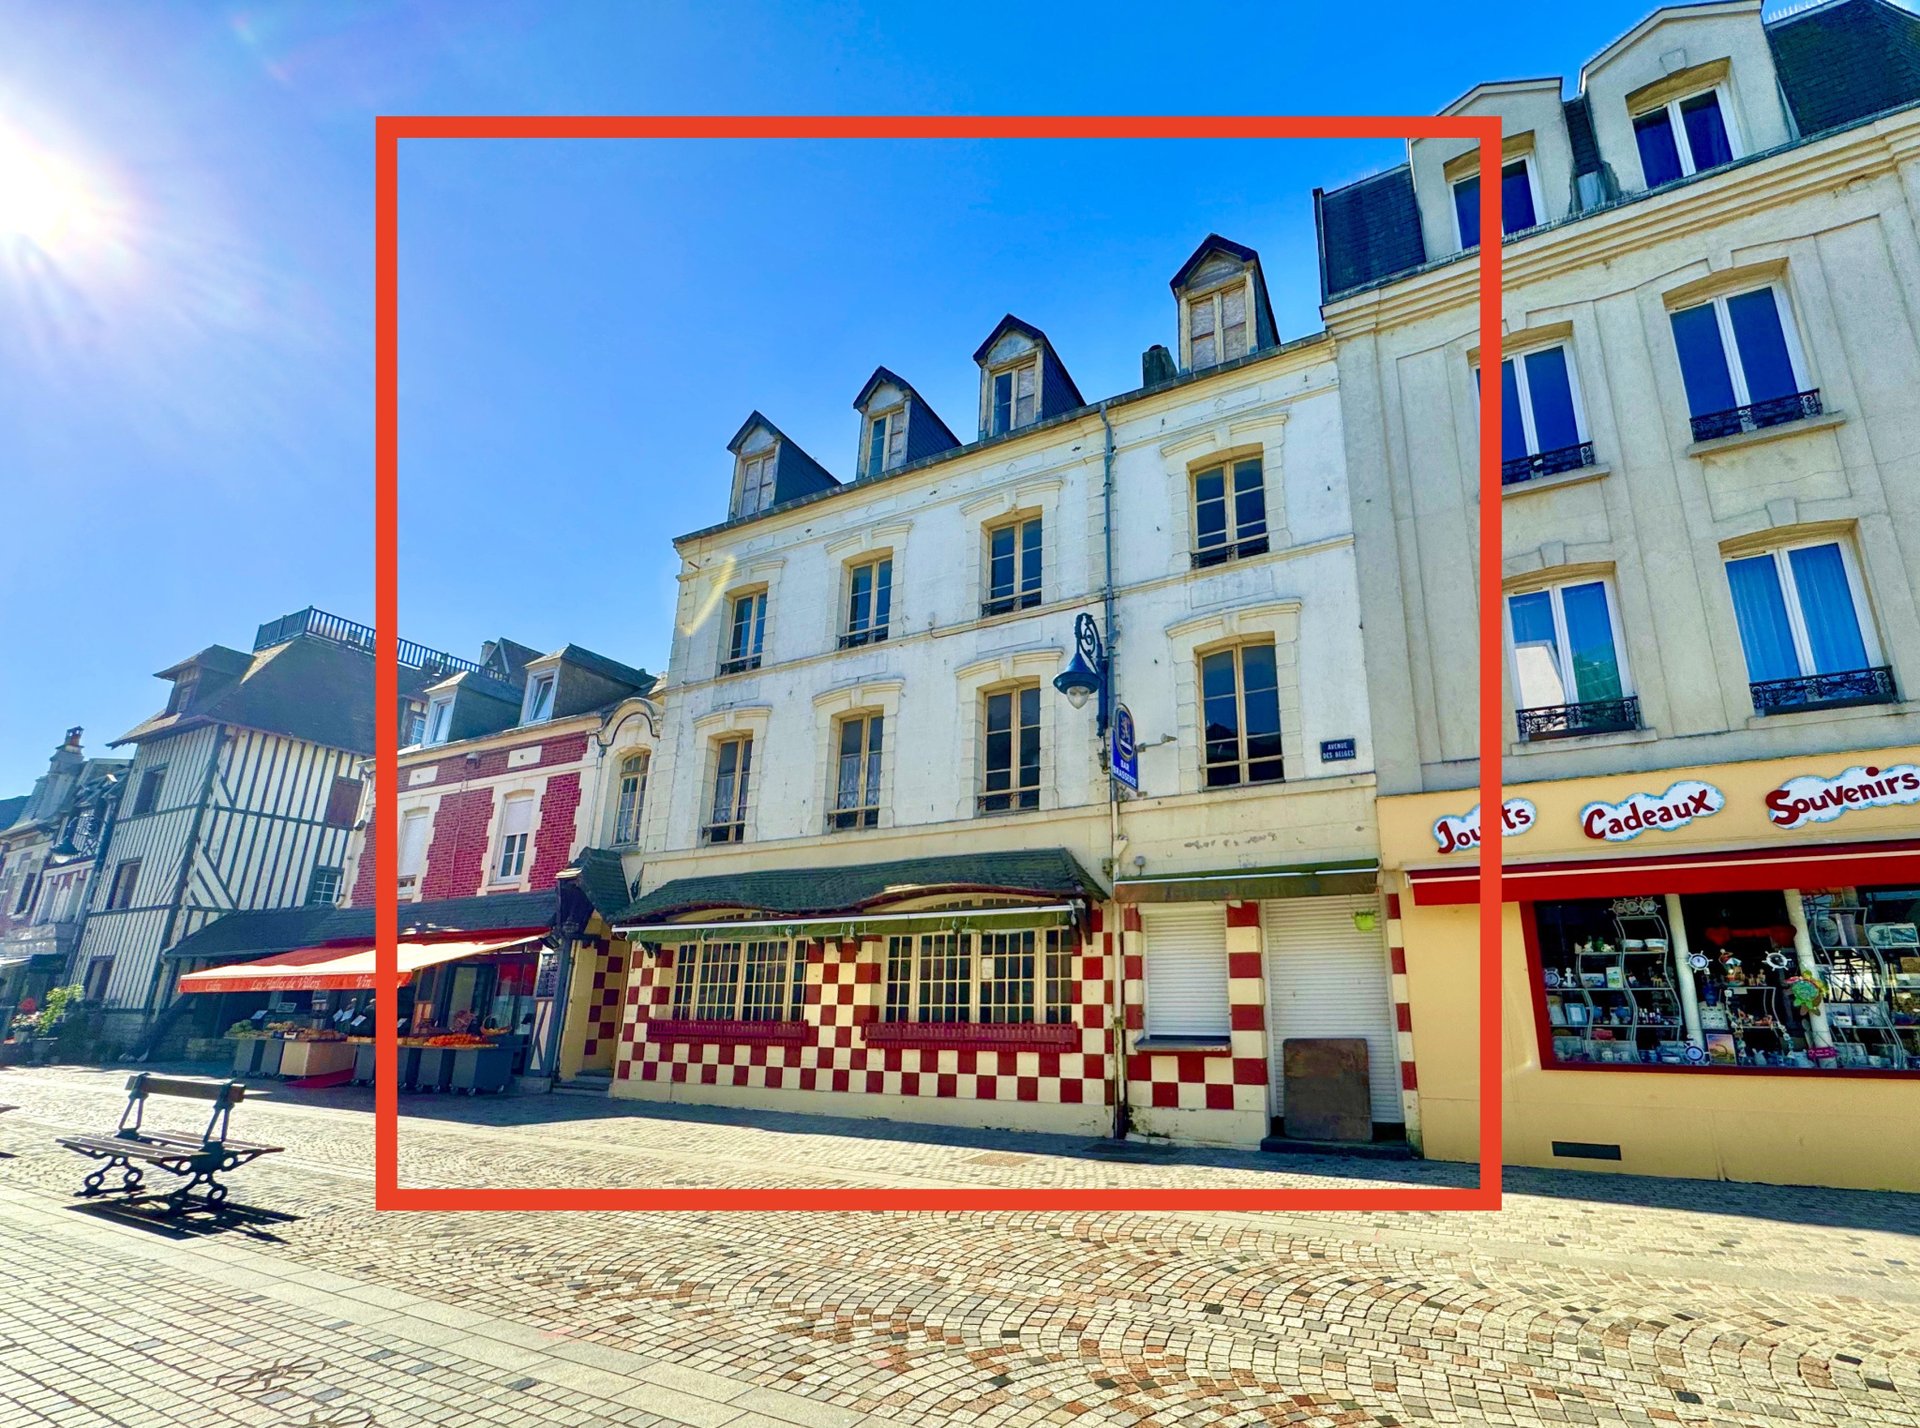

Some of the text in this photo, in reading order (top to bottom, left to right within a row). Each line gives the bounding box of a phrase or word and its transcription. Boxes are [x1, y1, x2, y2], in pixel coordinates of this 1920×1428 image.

[1327, 742, 1348, 750] AVENUE
[1322, 749, 1355, 760] DES BELGES
[1120, 759, 1130, 772] BAR
[1112, 765, 1137, 787] BRASSERIE
[1437, 804, 1531, 854] Jouts
